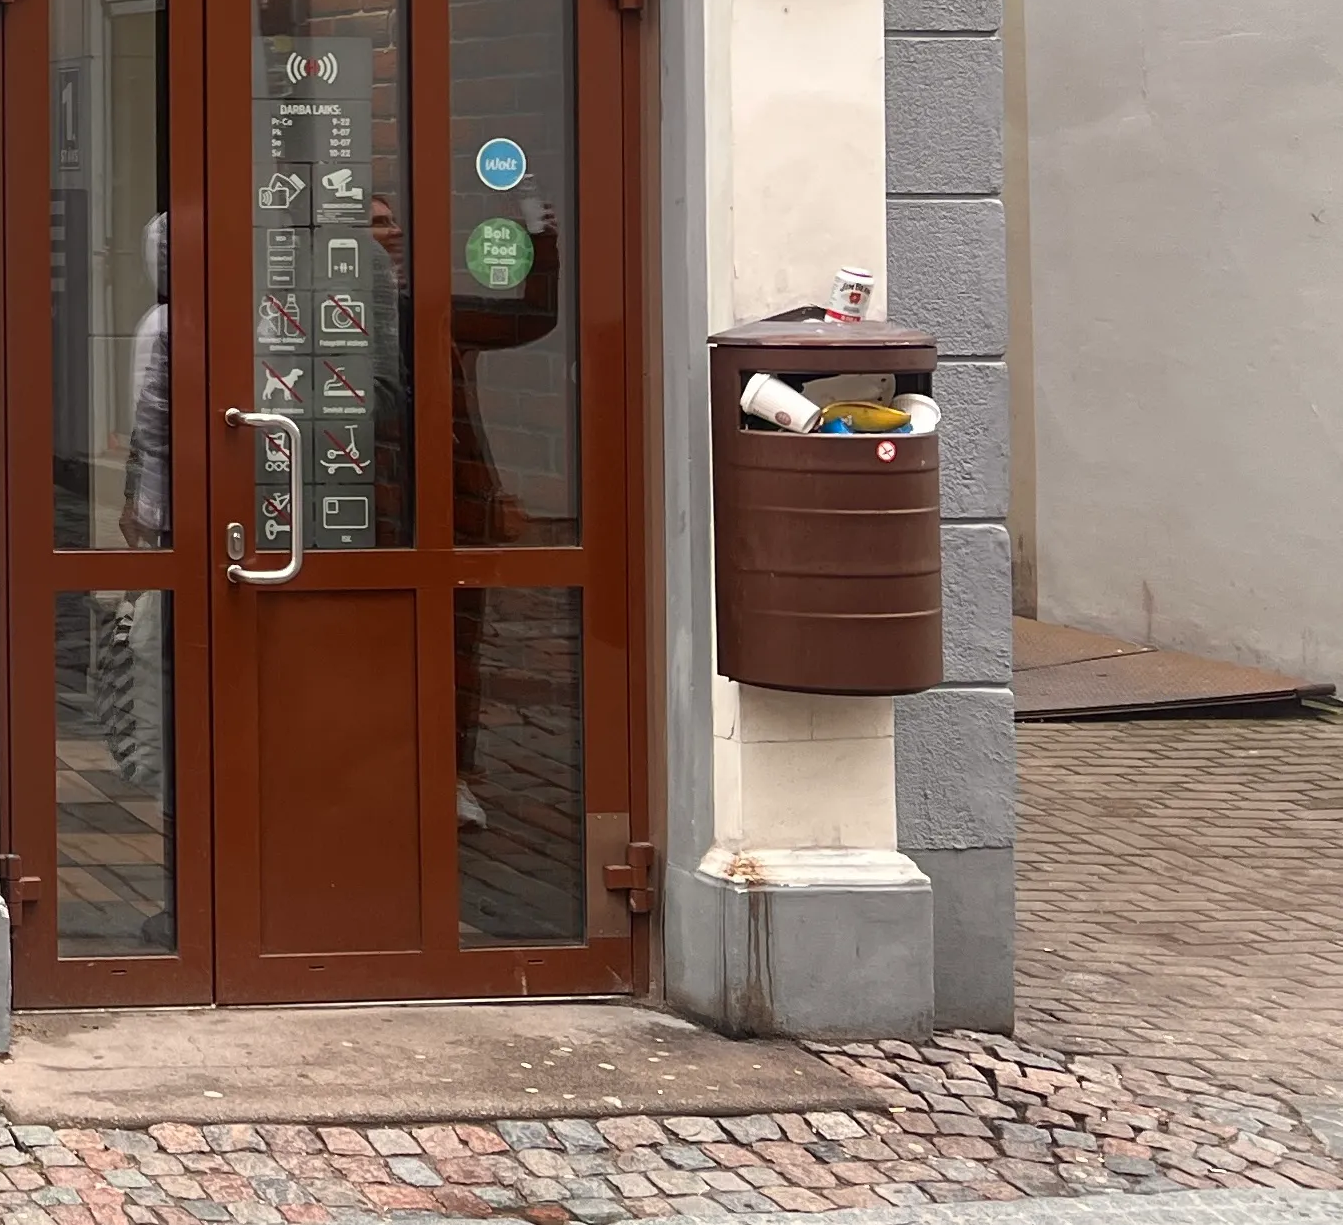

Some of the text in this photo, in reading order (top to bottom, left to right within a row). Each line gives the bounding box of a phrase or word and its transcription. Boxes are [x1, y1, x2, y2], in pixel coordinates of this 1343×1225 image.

[280, 105, 341, 115] DARBA LAIKS:
[271, 128, 282, 136] Pk
[485, 158, 518, 171] Wolt
[483, 226, 511, 240] Bolt
[483, 243, 517, 256] Food
